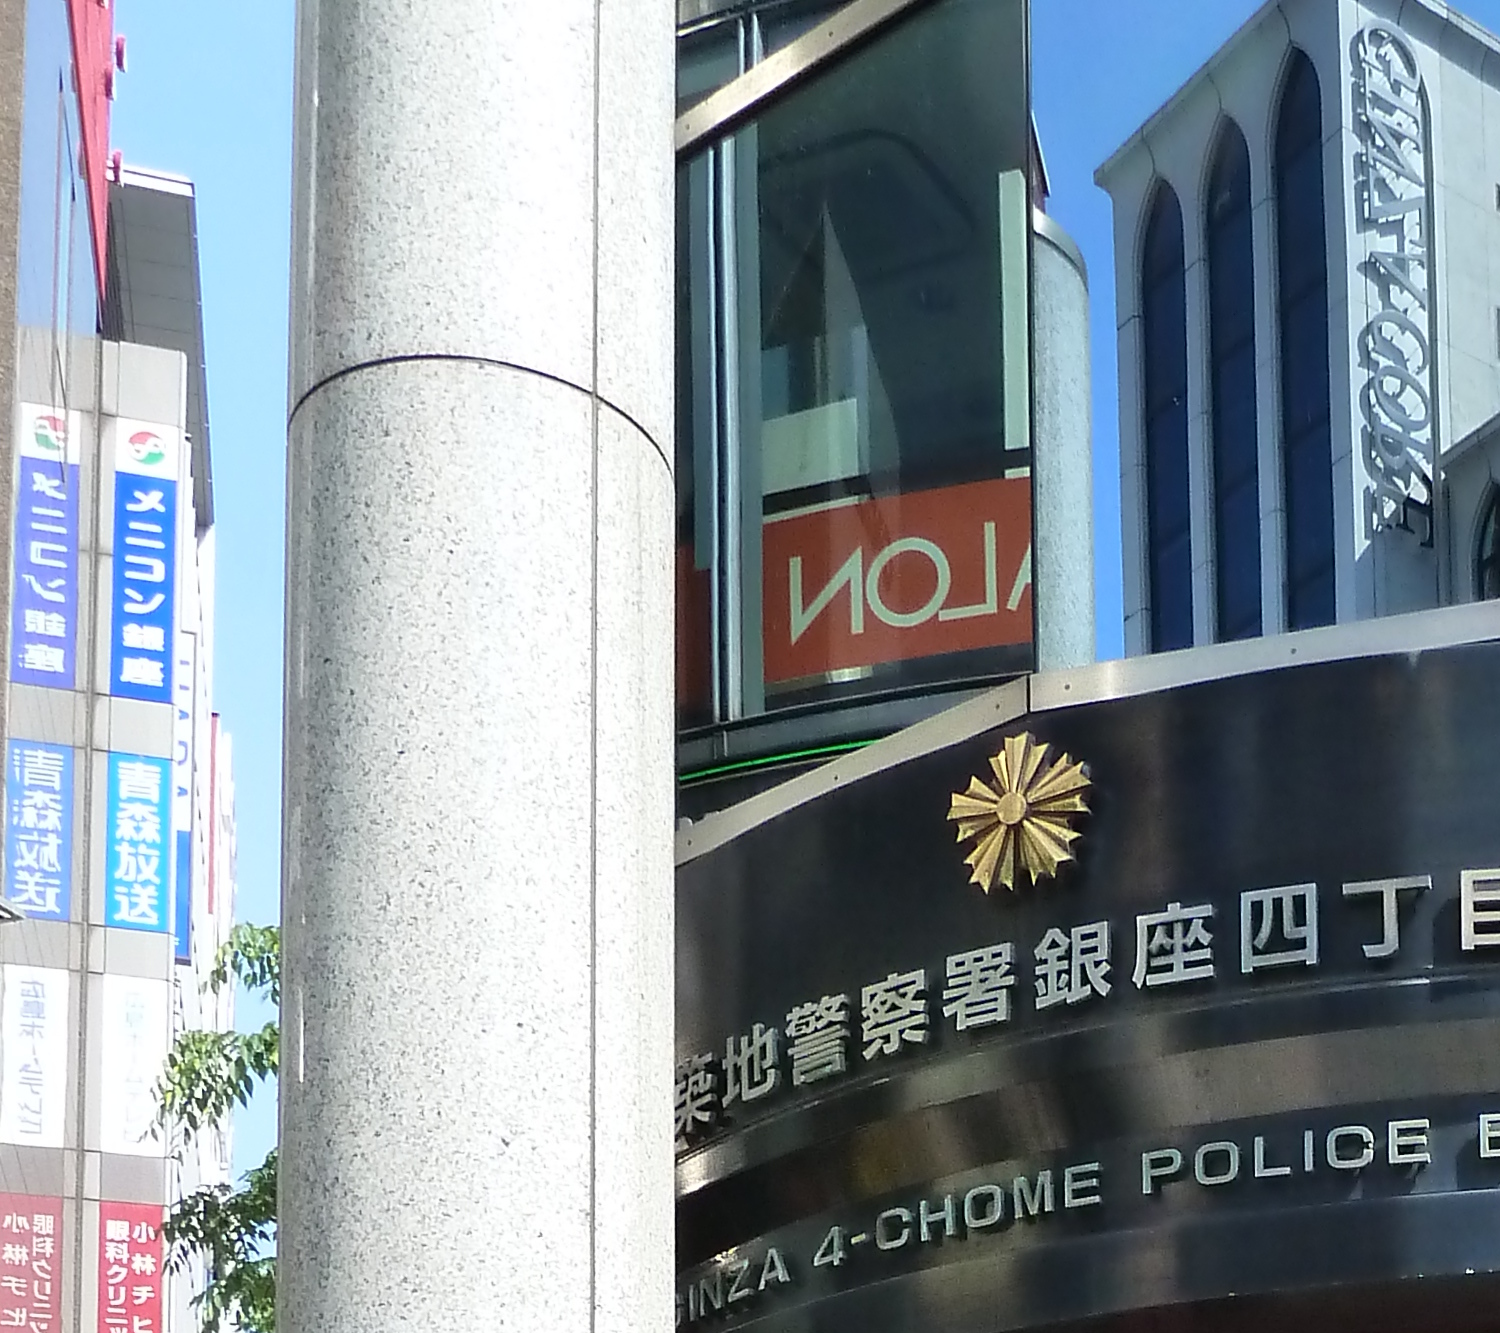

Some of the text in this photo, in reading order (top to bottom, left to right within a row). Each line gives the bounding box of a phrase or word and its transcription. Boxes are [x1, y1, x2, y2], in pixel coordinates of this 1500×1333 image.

[119, 490, 167, 688] メニコン銀座
[114, 761, 162, 926] 青森放送
[675, 1247, 791, 1326] INZA
[813, 1161, 1103, 1267] 4-CHOME
[1142, 1118, 1432, 1195] POLICE
